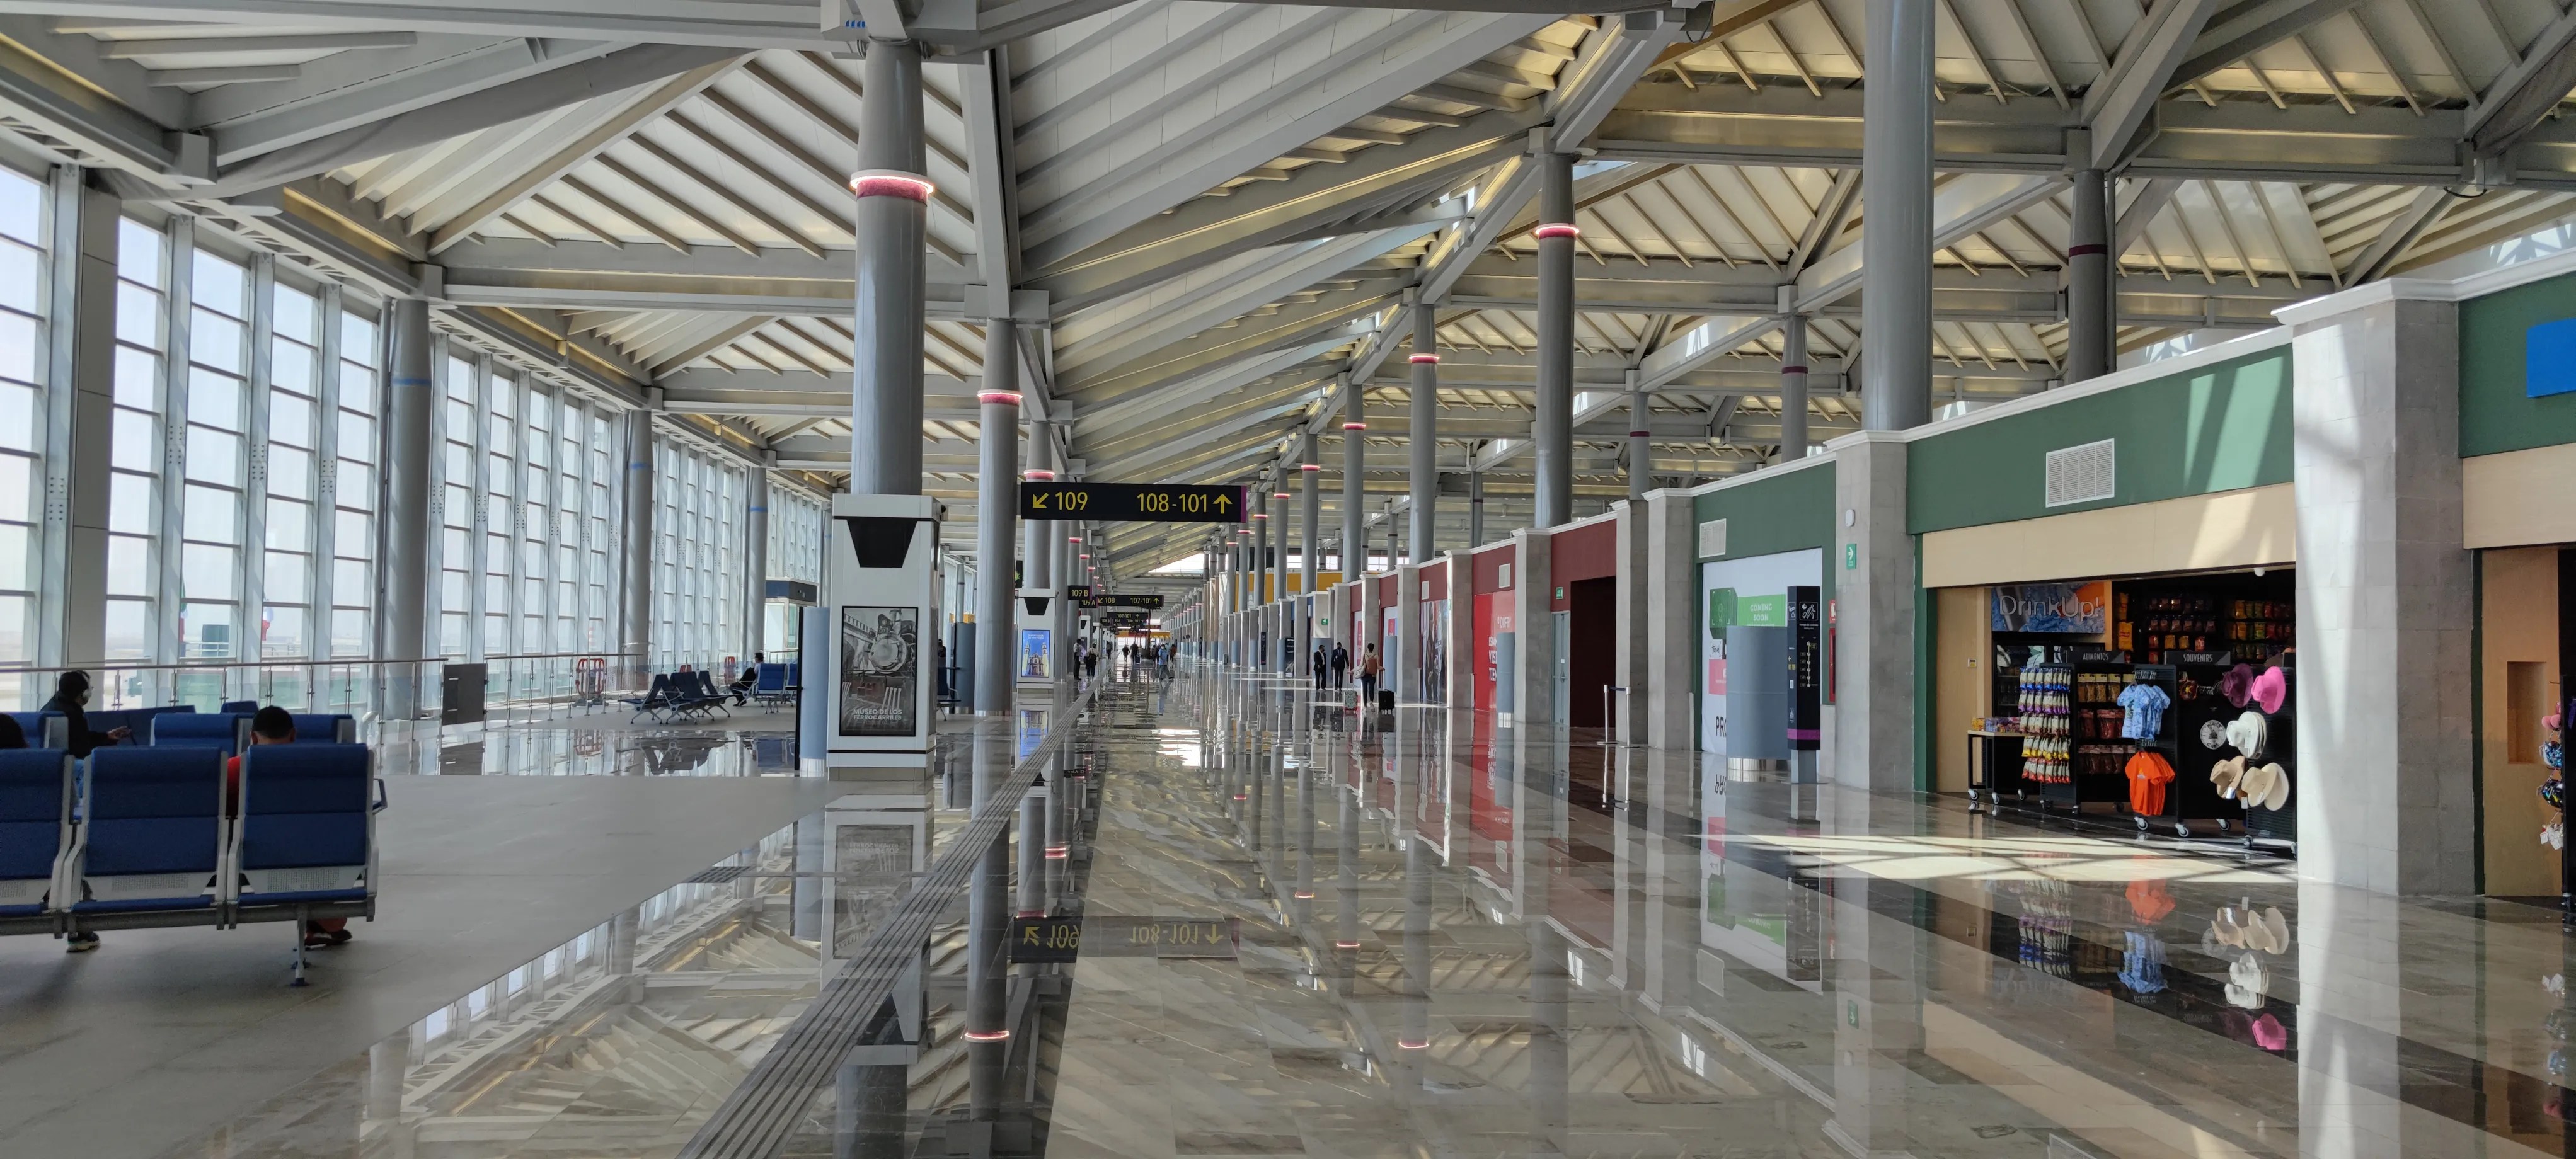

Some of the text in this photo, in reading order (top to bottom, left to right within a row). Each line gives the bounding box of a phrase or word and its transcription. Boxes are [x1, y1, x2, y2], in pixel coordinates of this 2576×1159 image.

[1055, 491, 1207, 513] 109 108-101
[1750, 603, 1772, 612] COMING
[1753, 613, 1768, 621] SOON
[2183, 654, 2213, 663] SOUVENIRS
